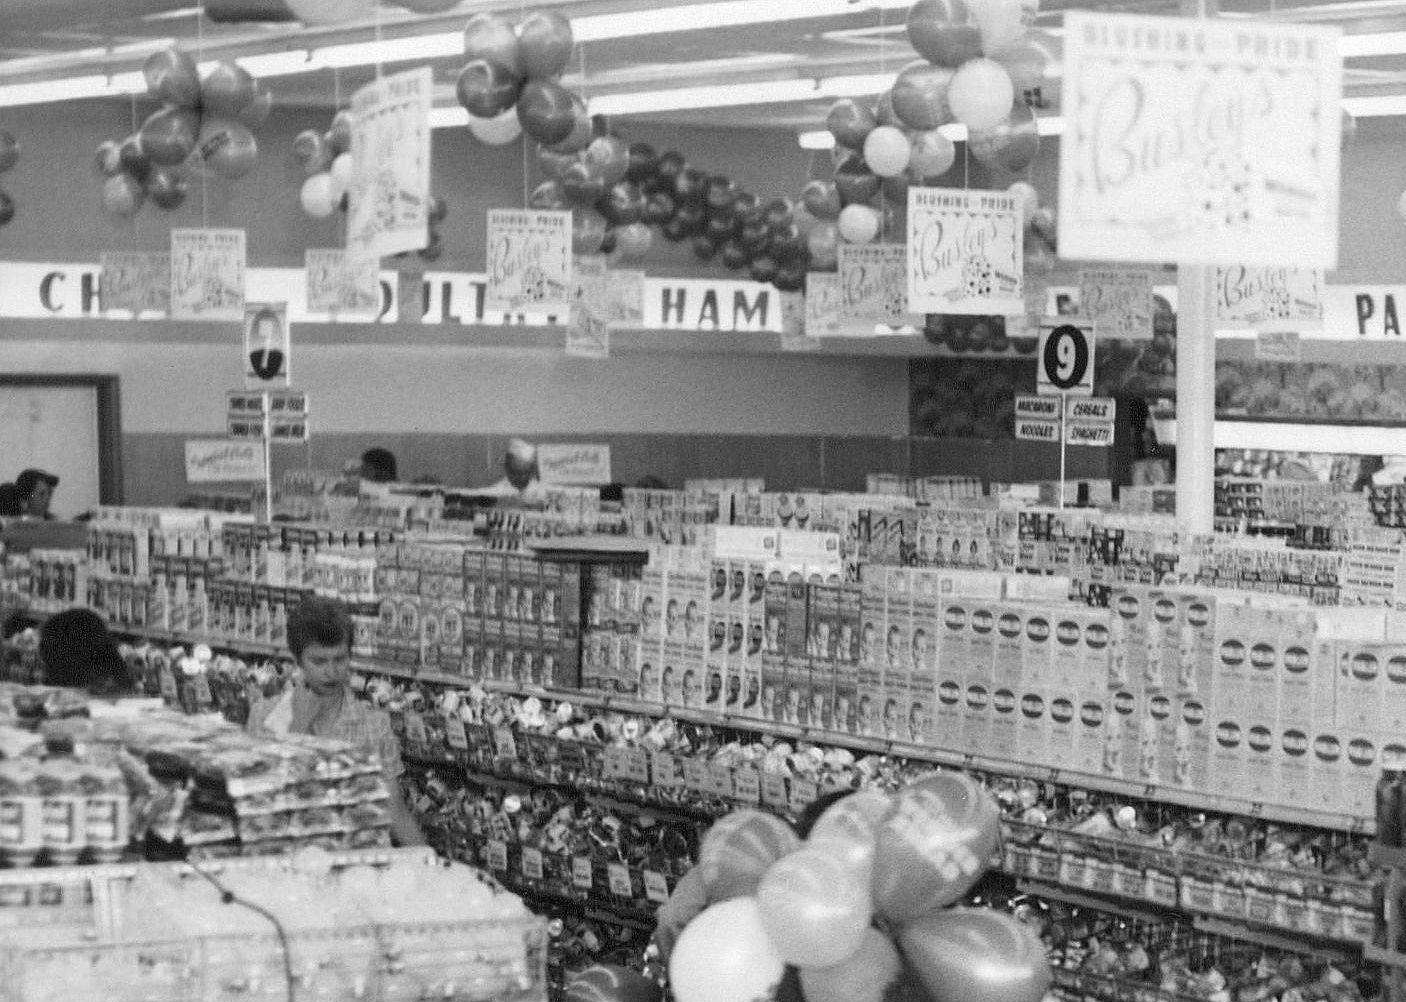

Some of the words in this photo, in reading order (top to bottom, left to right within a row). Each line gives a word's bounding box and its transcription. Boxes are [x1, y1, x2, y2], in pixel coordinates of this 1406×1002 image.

[1236, 33, 1319, 62] PRIDE
[916, 193, 970, 209] BLUSHING
[980, 196, 1016, 211] PRIDE
[661, 286, 770, 328] HAM
[1055, 334, 1077, 381] 9
[1072, 402, 1108, 417] CEREALS
[1020, 423, 1055, 438] NOODLES
